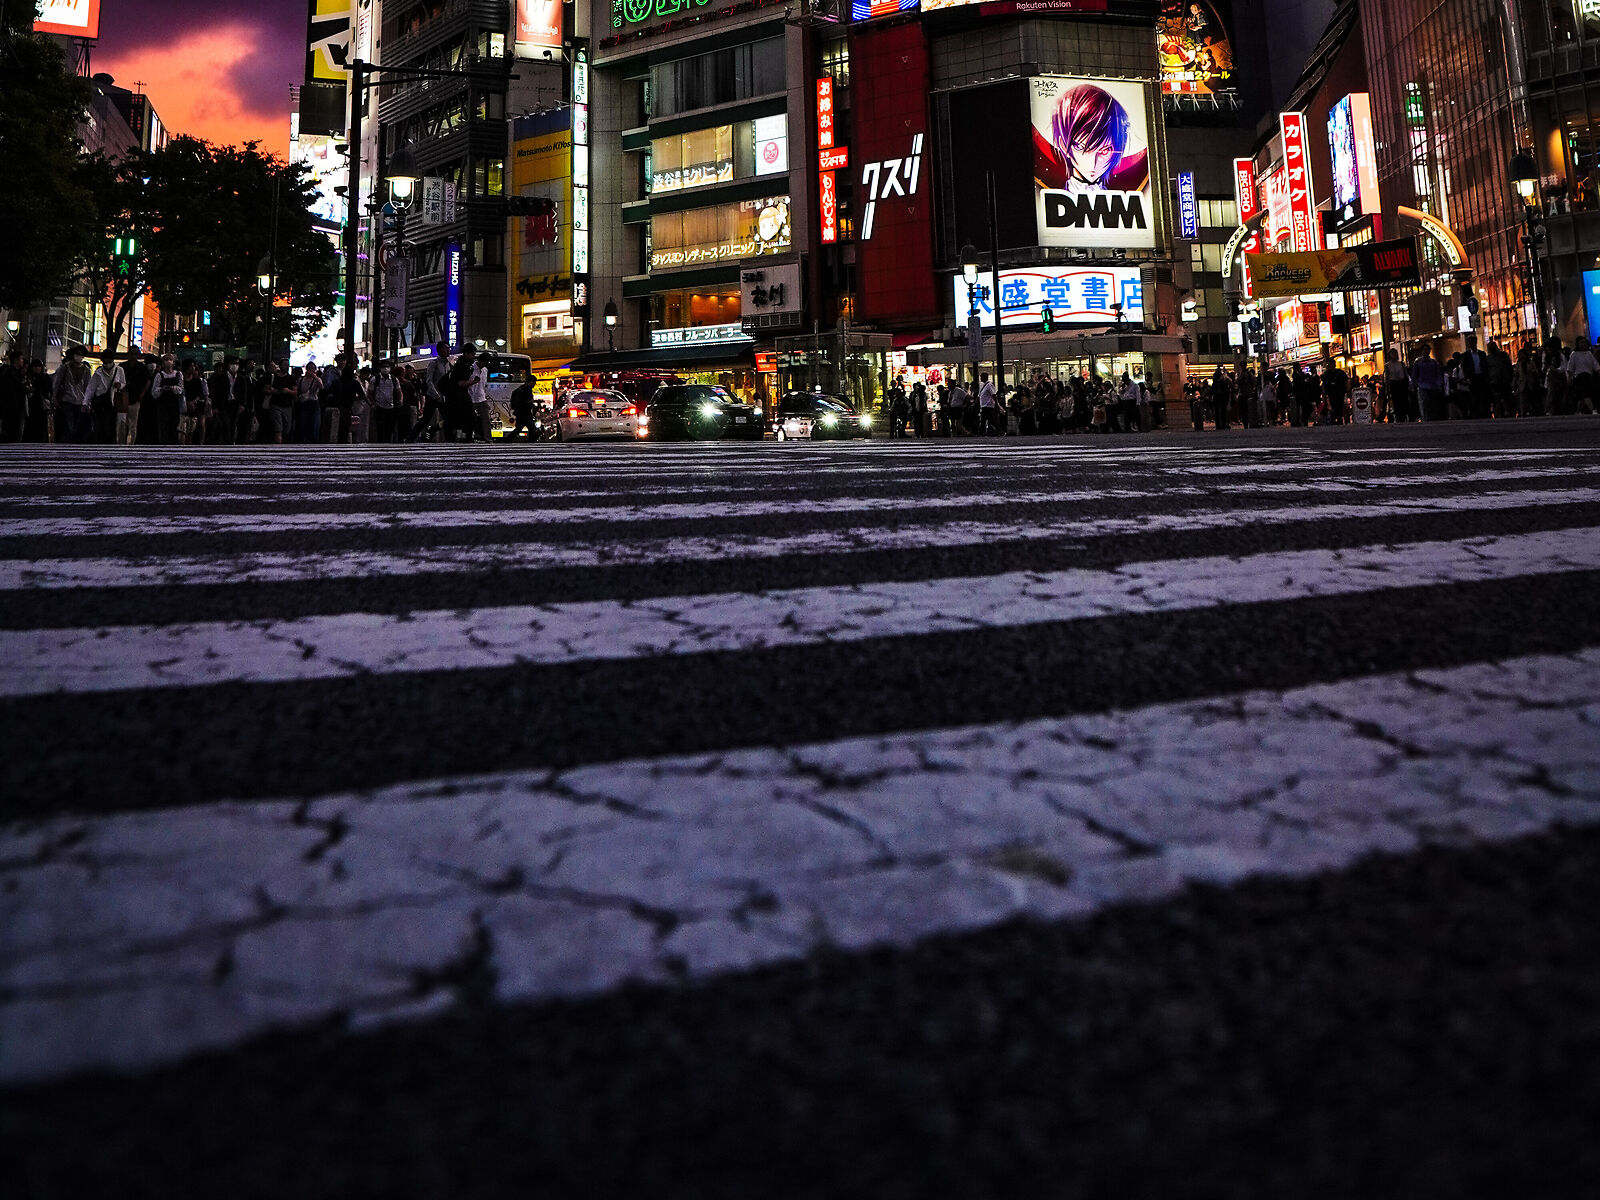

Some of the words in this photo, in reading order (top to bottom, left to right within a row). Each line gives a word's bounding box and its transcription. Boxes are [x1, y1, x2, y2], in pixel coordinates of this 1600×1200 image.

[613, 0, 623, 28] 渋谷
[1016, 1, 1045, 10] Rakuten
[1047, 0, 1071, 9] Vision
[819, 82, 832, 145] お好み焼
[517, 145, 552, 158] Matsumoto
[1285, 124, 1307, 203] カラオケ
[861, 133, 924, 240] クスリ
[1238, 170, 1248, 188] BIG
[430, 181, 441, 222] 渋谷駅前
[822, 175, 834, 240] もんじゃ焼
[1044, 193, 1147, 229] DMM
[1181, 175, 1195, 235] 大盛堂商事ビル
[1242, 188, 1251, 212] ECHO
[1293, 211, 1305, 231] BIG
[1298, 231, 1307, 252] ECH
[451, 251, 459, 286] MIZUHO
[967, 277, 1142, 316] 大盛堂書店
[686, 327, 741, 340] フルーツパーラー
